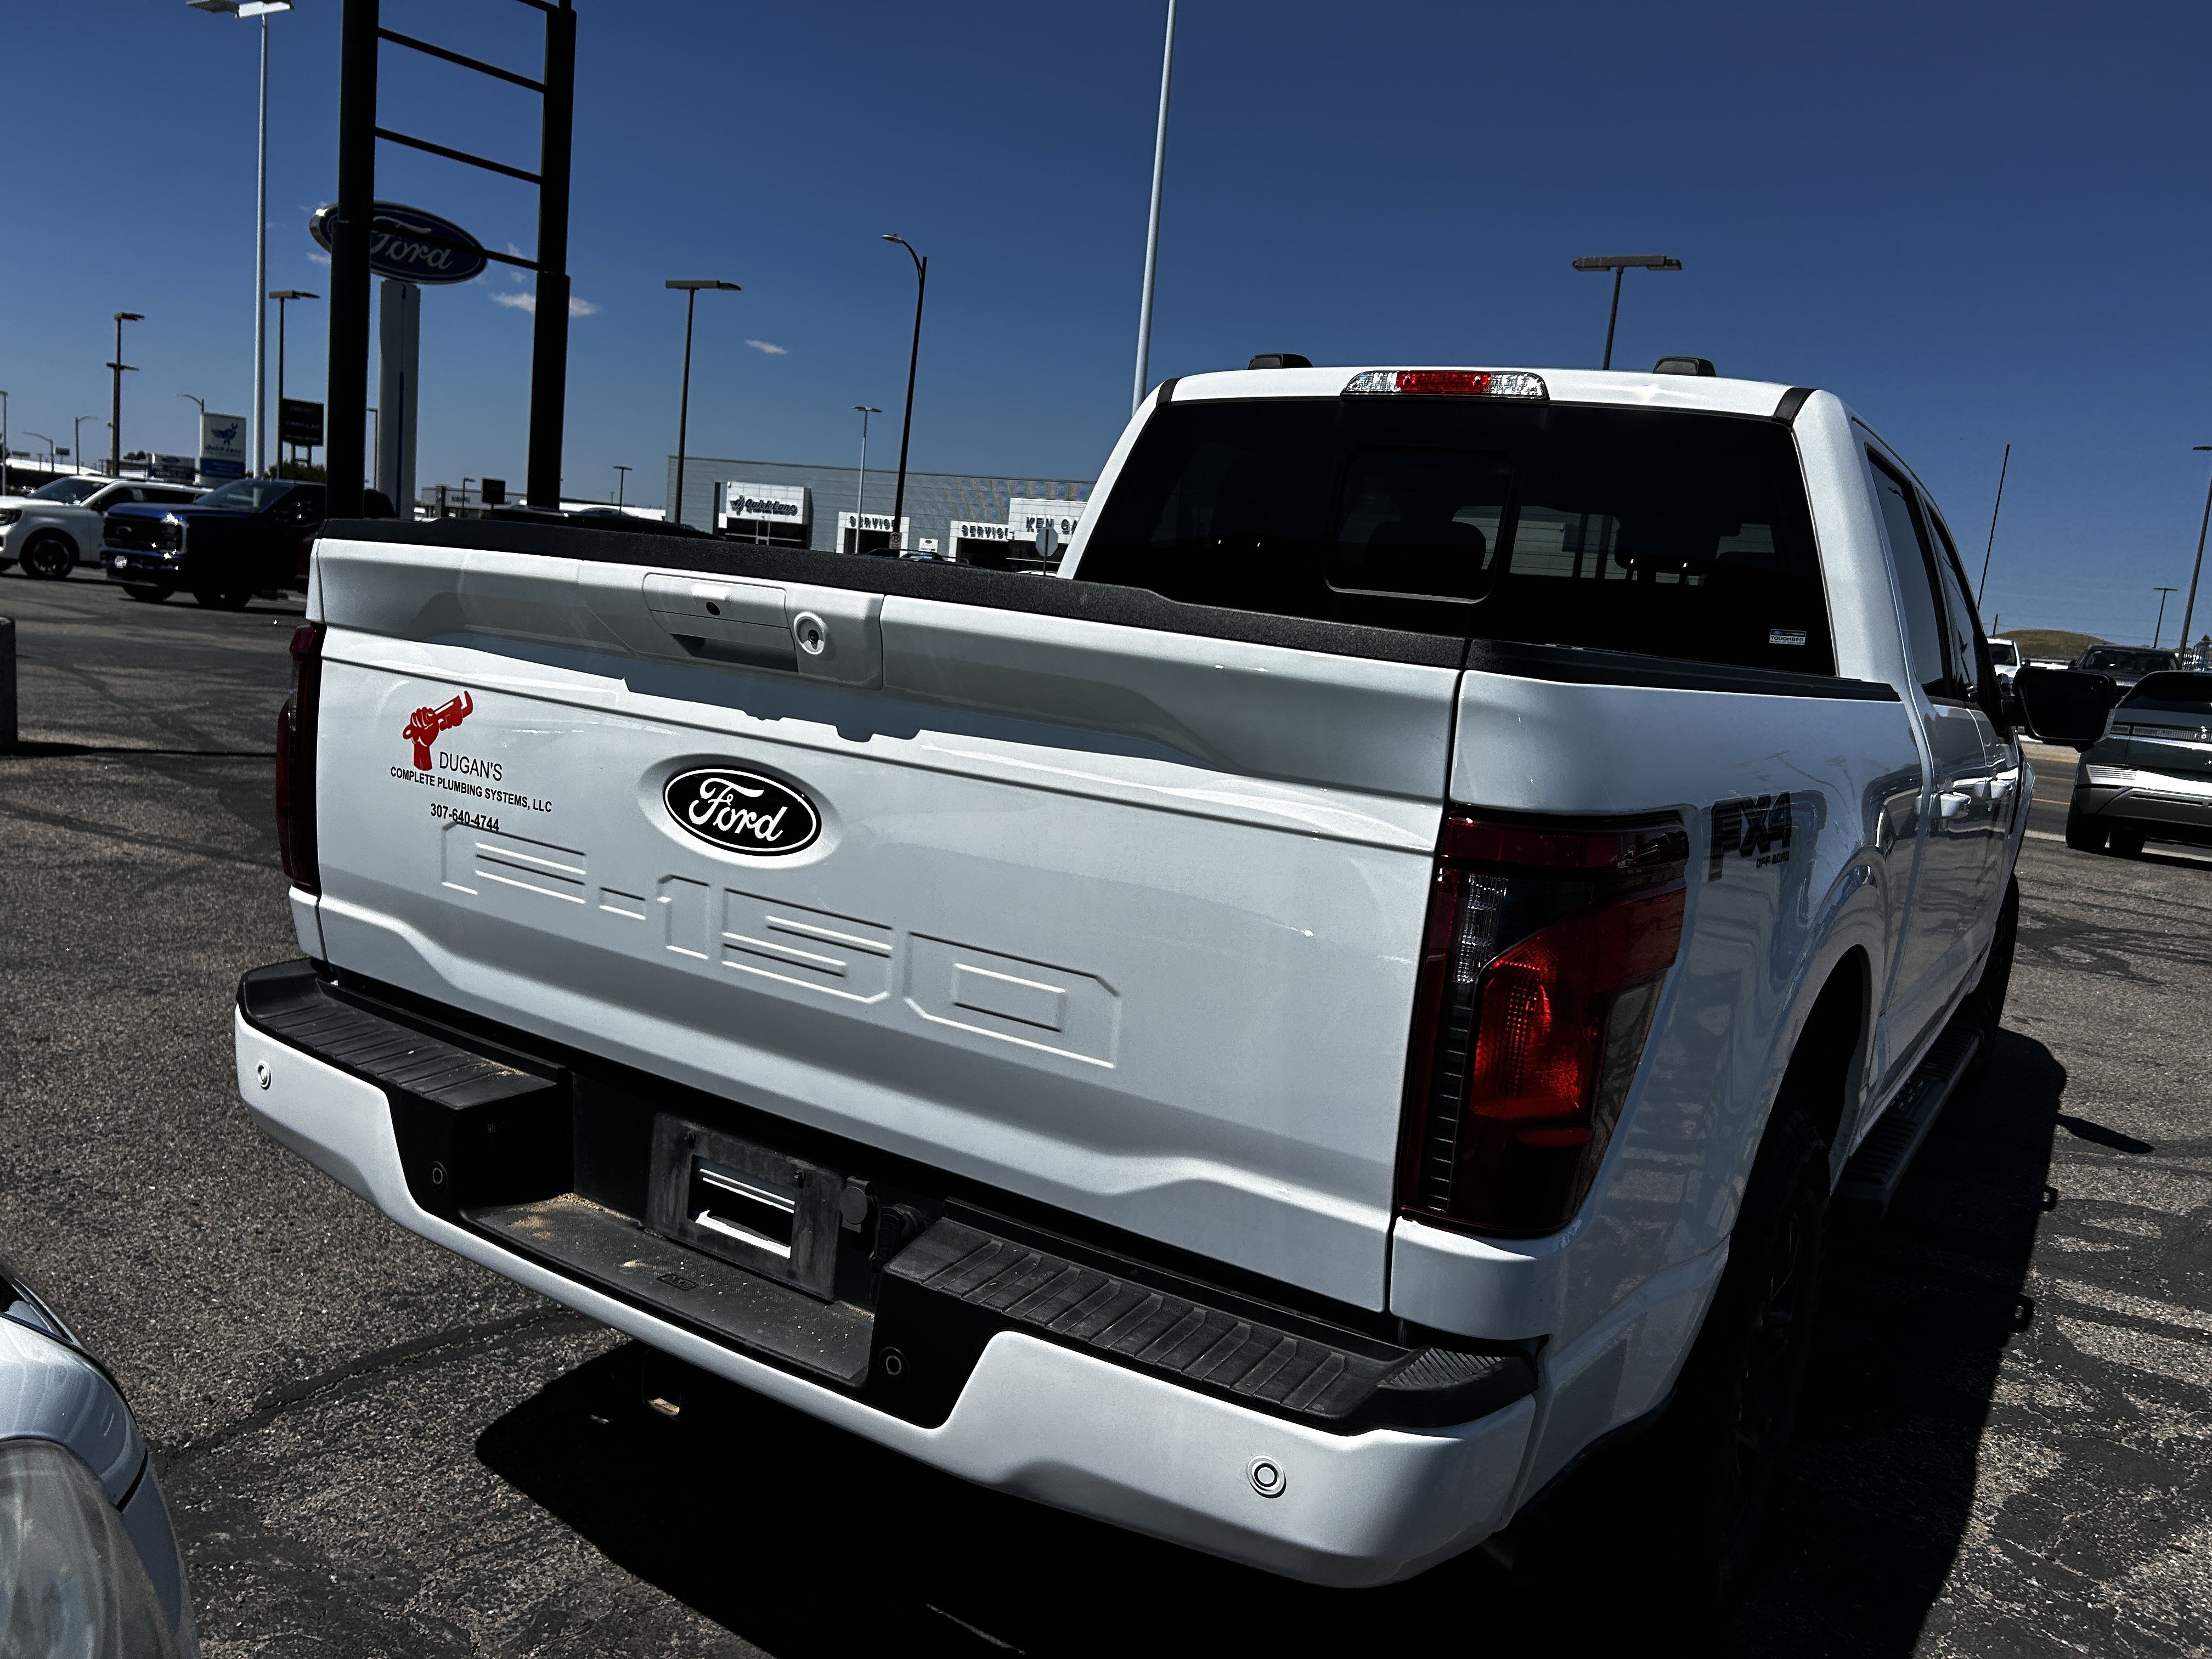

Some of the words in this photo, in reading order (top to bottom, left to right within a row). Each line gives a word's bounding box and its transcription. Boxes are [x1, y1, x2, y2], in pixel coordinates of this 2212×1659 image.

[745, 499, 772, 511] Quick
[772, 501, 796, 512] Lane
[849, 516, 895, 528] SRVIC
[1025, 517, 1054, 529] KEN
[439, 751, 503, 781] DUGAN'S
[391, 766, 435, 786] COMPLETE
[437, 777, 482, 797] PLUMBING
[484, 788, 530, 811] SYSTEMS,
[533, 799, 552, 812] LLC
[431, 803, 500, 832] 307-640-4744
[689, 777, 788, 842] Ford
[1708, 790, 1792, 883] FX4
[1756, 856, 1770, 868] OFF
[1772, 851, 1790, 865] ROAD
[441, 821, 1121, 1069] F-150
